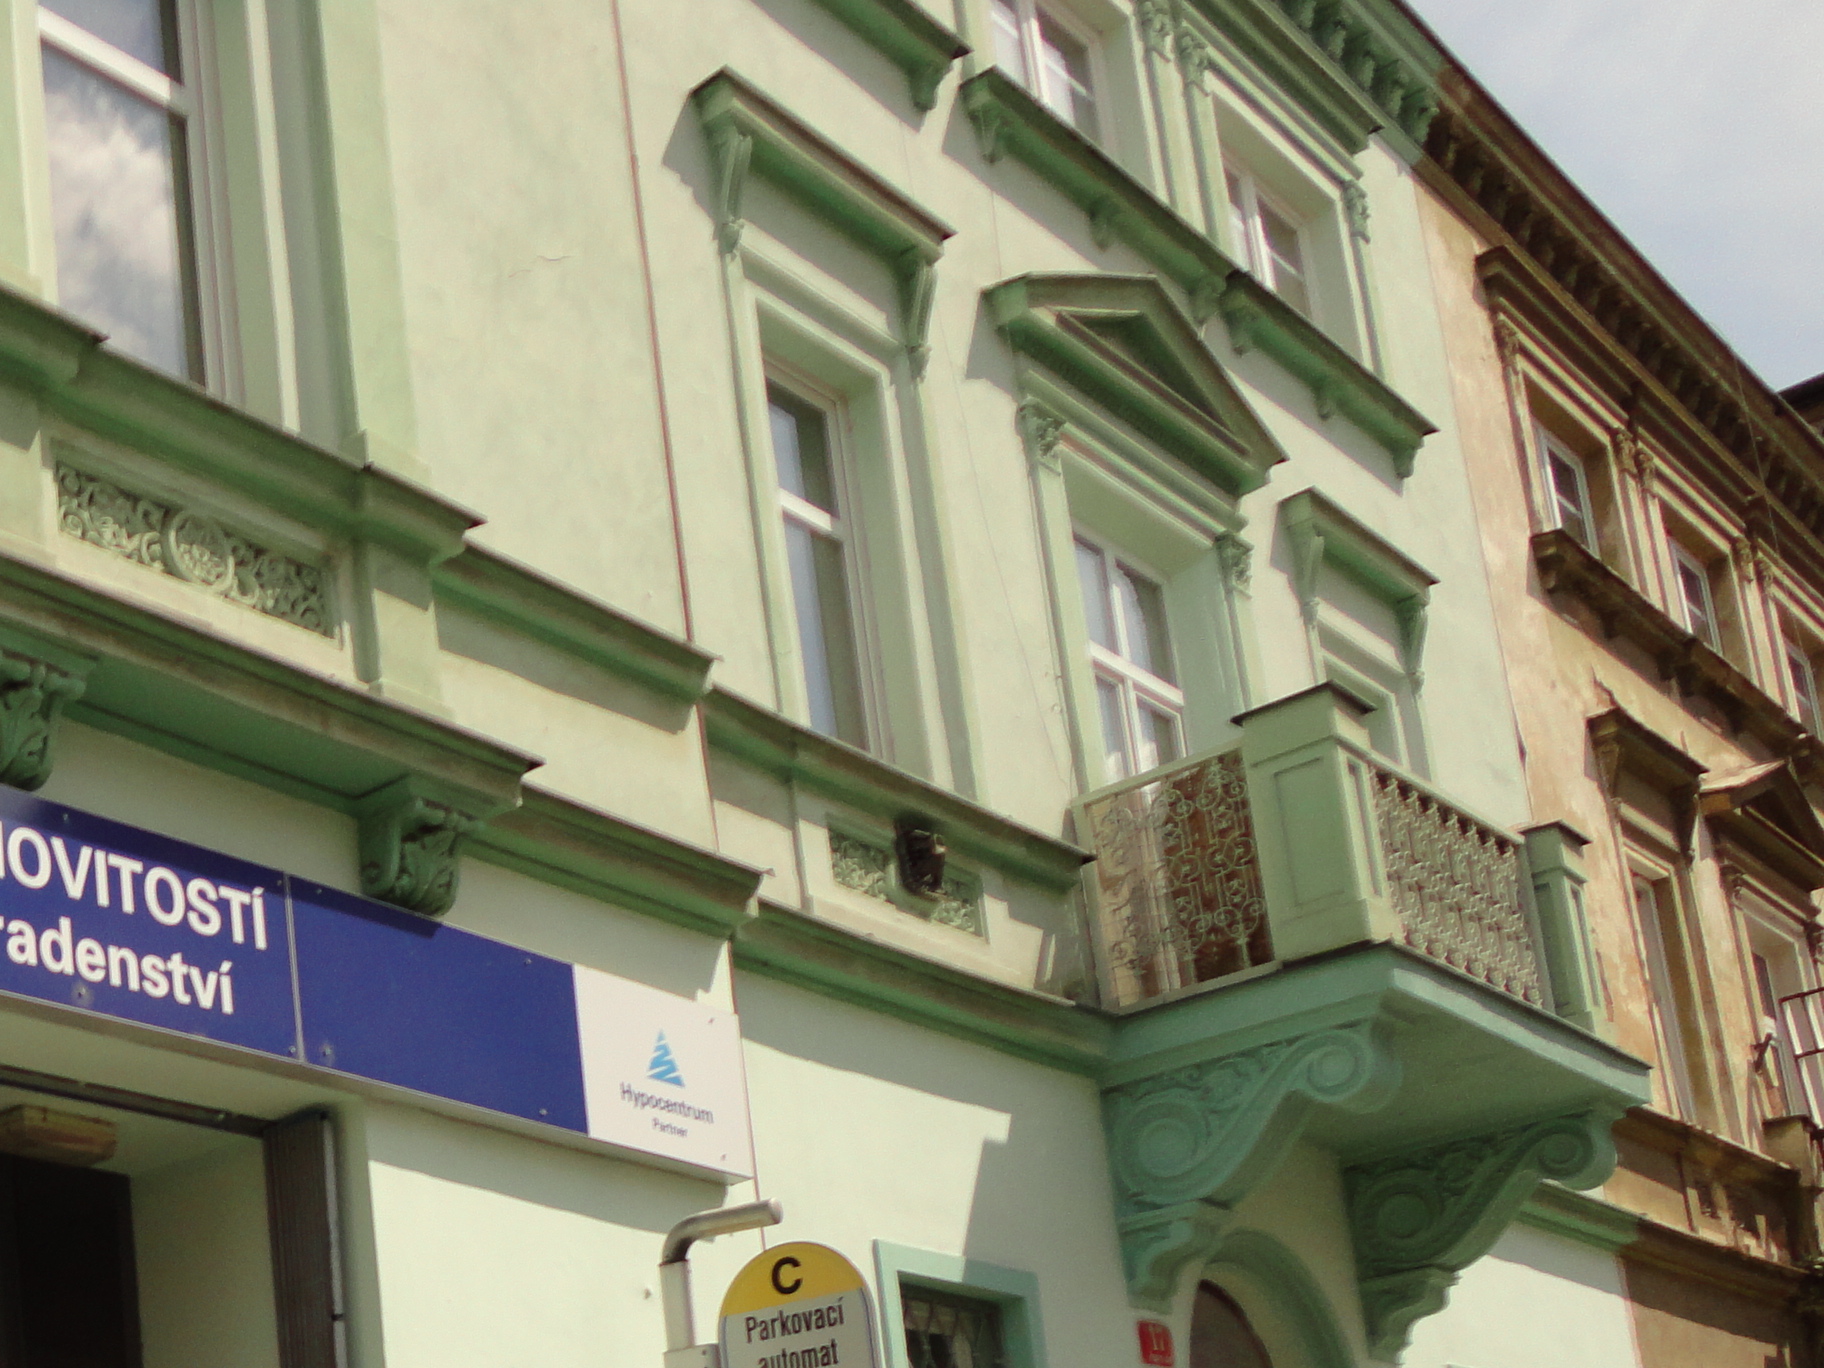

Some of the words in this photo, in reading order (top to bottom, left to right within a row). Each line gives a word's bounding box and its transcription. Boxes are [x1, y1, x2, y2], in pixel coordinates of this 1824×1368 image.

[619, 1081, 714, 1124] Hypocentrum
[771, 1256, 803, 1295] C
[745, 1297, 845, 1344] Parkovací
